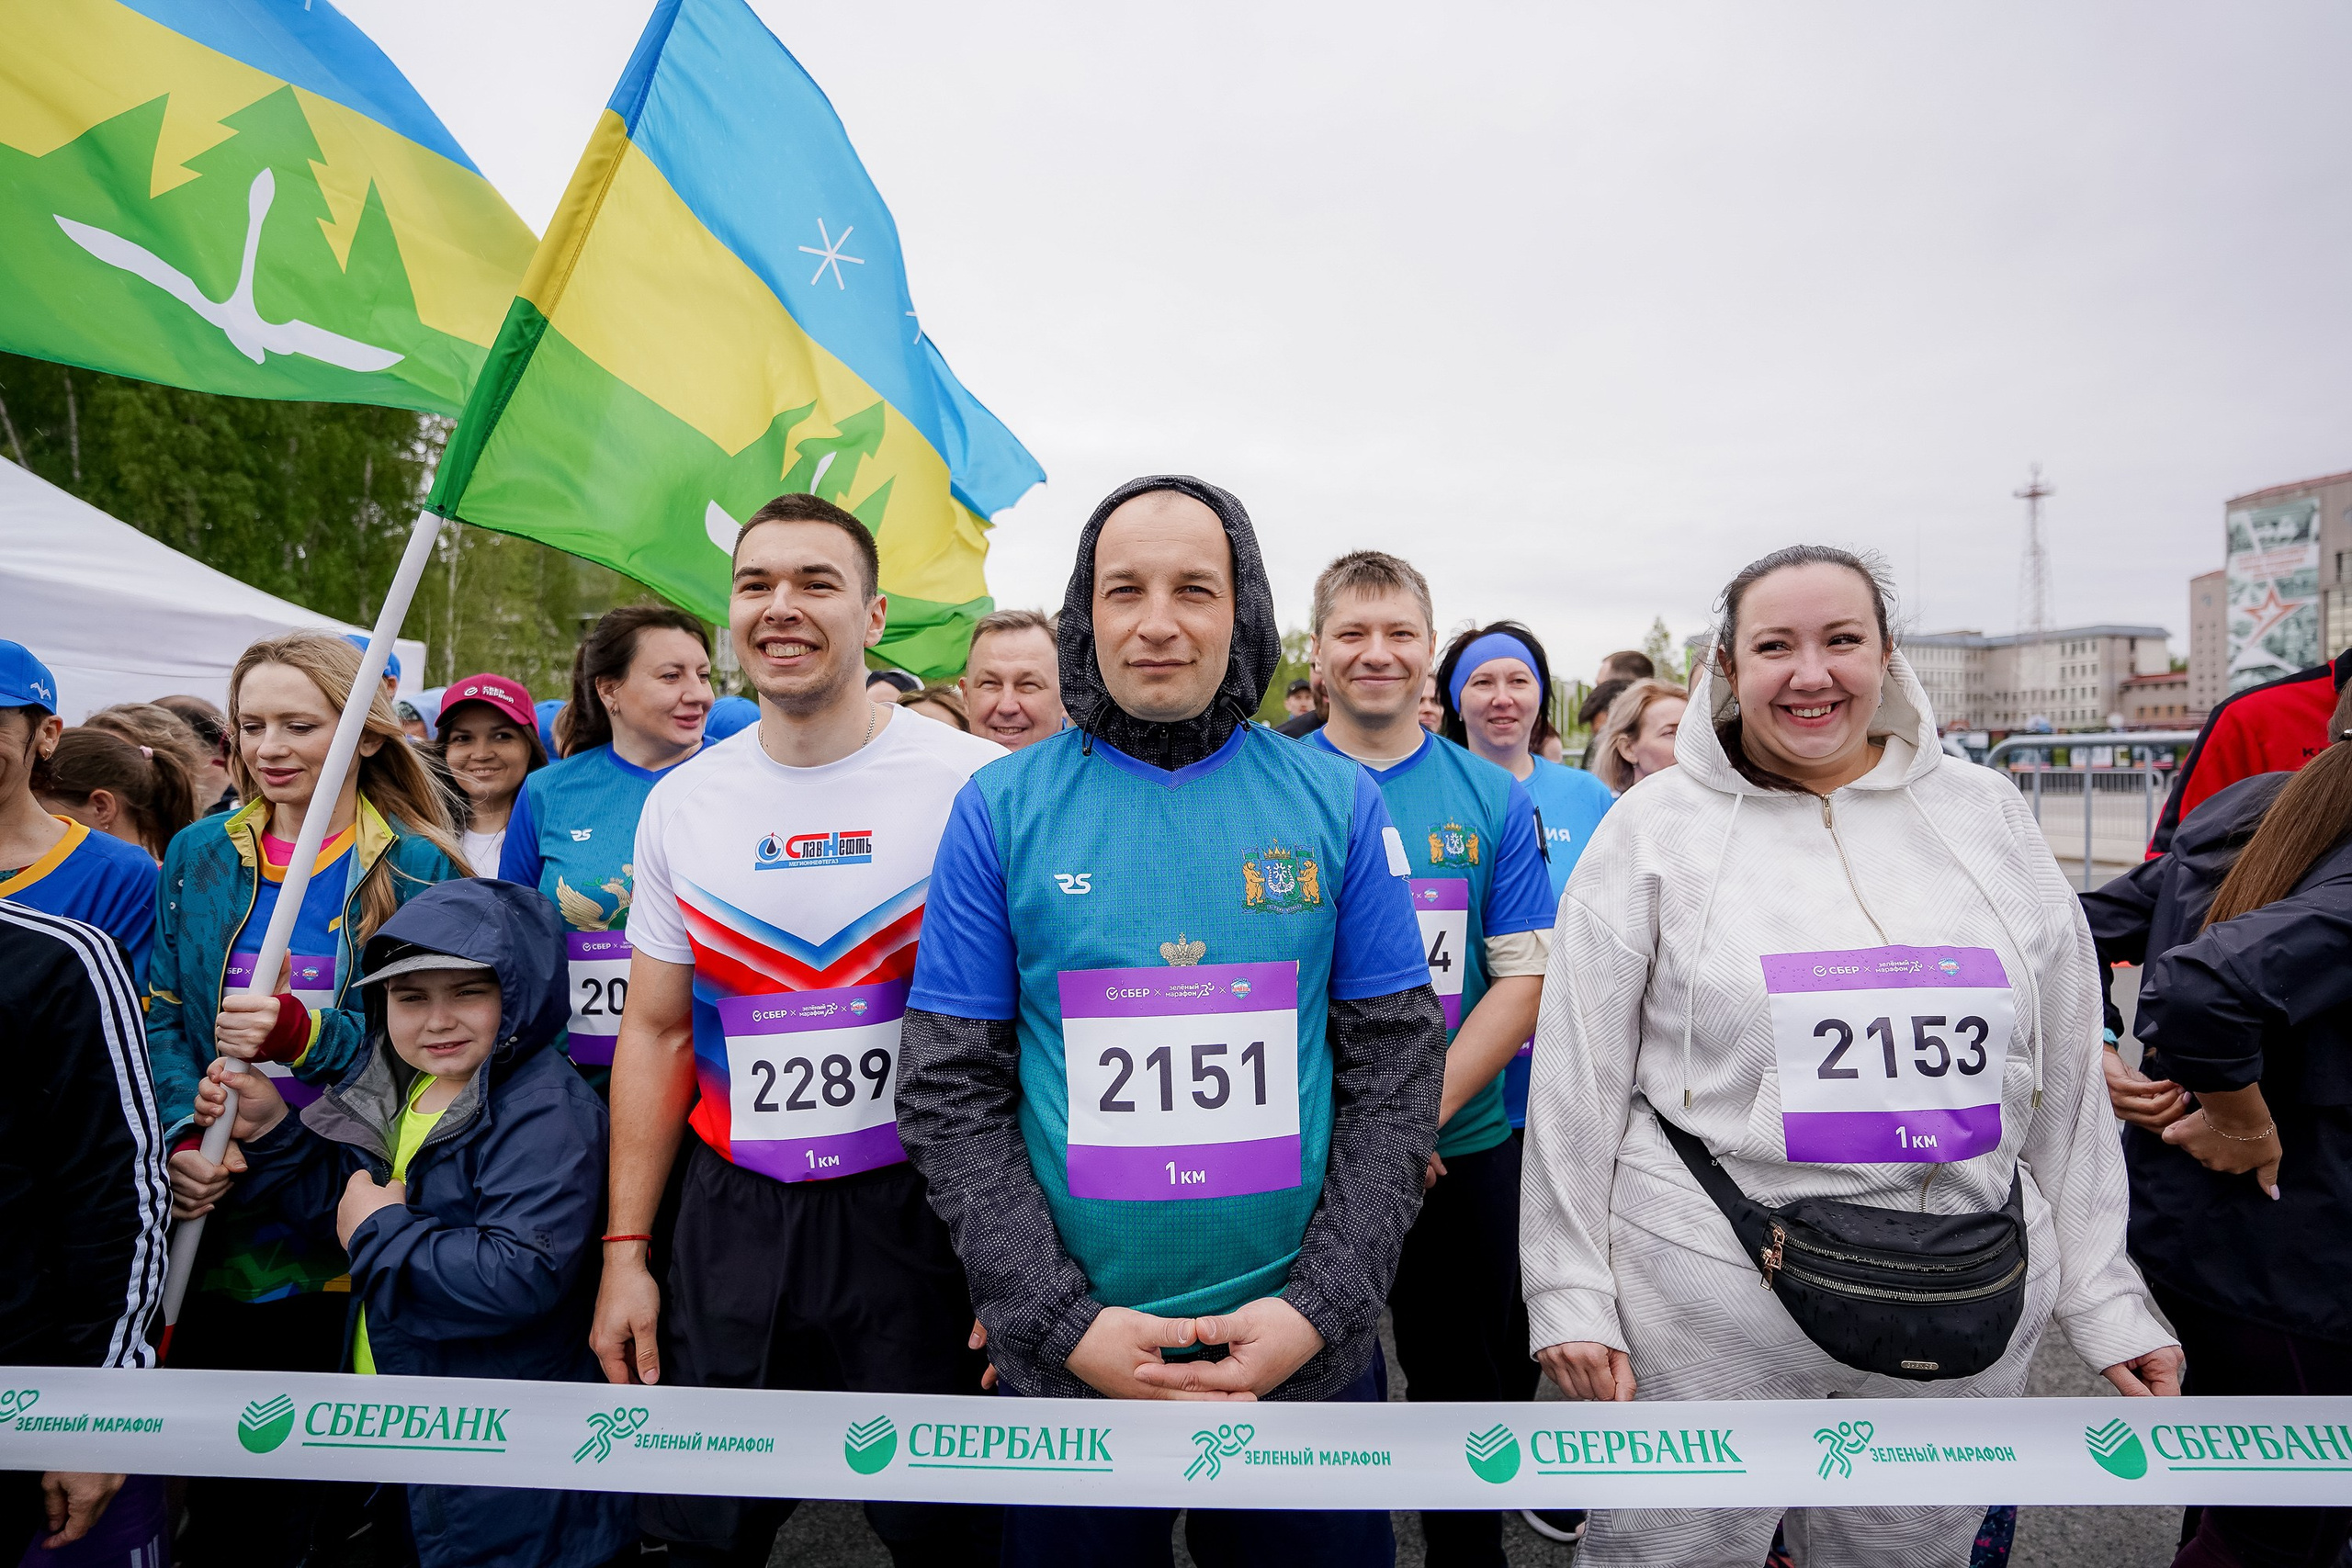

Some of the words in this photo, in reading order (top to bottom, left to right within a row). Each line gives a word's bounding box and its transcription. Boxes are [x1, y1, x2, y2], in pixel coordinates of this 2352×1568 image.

[1828, 965, 1860, 975] СБЕР
[1875, 966, 1908, 975] марафон
[1120, 988, 1150, 998] СБЕР
[1165, 990, 1197, 998] марафон
[1169, 983, 1199, 991] зелёный
[763, 1010, 787, 1020] СБЕР
[1813, 1015, 1989, 1080] 2153
[751, 1047, 892, 1112] 2289
[1099, 1041, 1267, 1112] 2151
[14, 1413, 90, 1433] ЗЕЛЕНЫЙ
[92, 1416, 164, 1434] МАРАФОН
[304, 1402, 511, 1441] СБЕРБАНК
[634, 1431, 703, 1451] ЗЕЛЕНЫЙ
[706, 1435, 775, 1453] МАРАФОН
[908, 1423, 1113, 1462] СБЕРБАНК
[1530, 1428, 1743, 1465] СБЕРБАНК
[1244, 1447, 1315, 1467] ЗЕЛЕНЫЙ
[1318, 1450, 1392, 1467] МАРАФОН
[1870, 1443, 1940, 1463] ЗЕЛЕНЫЙ
[1941, 1445, 2018, 1462] МАРАФОН
